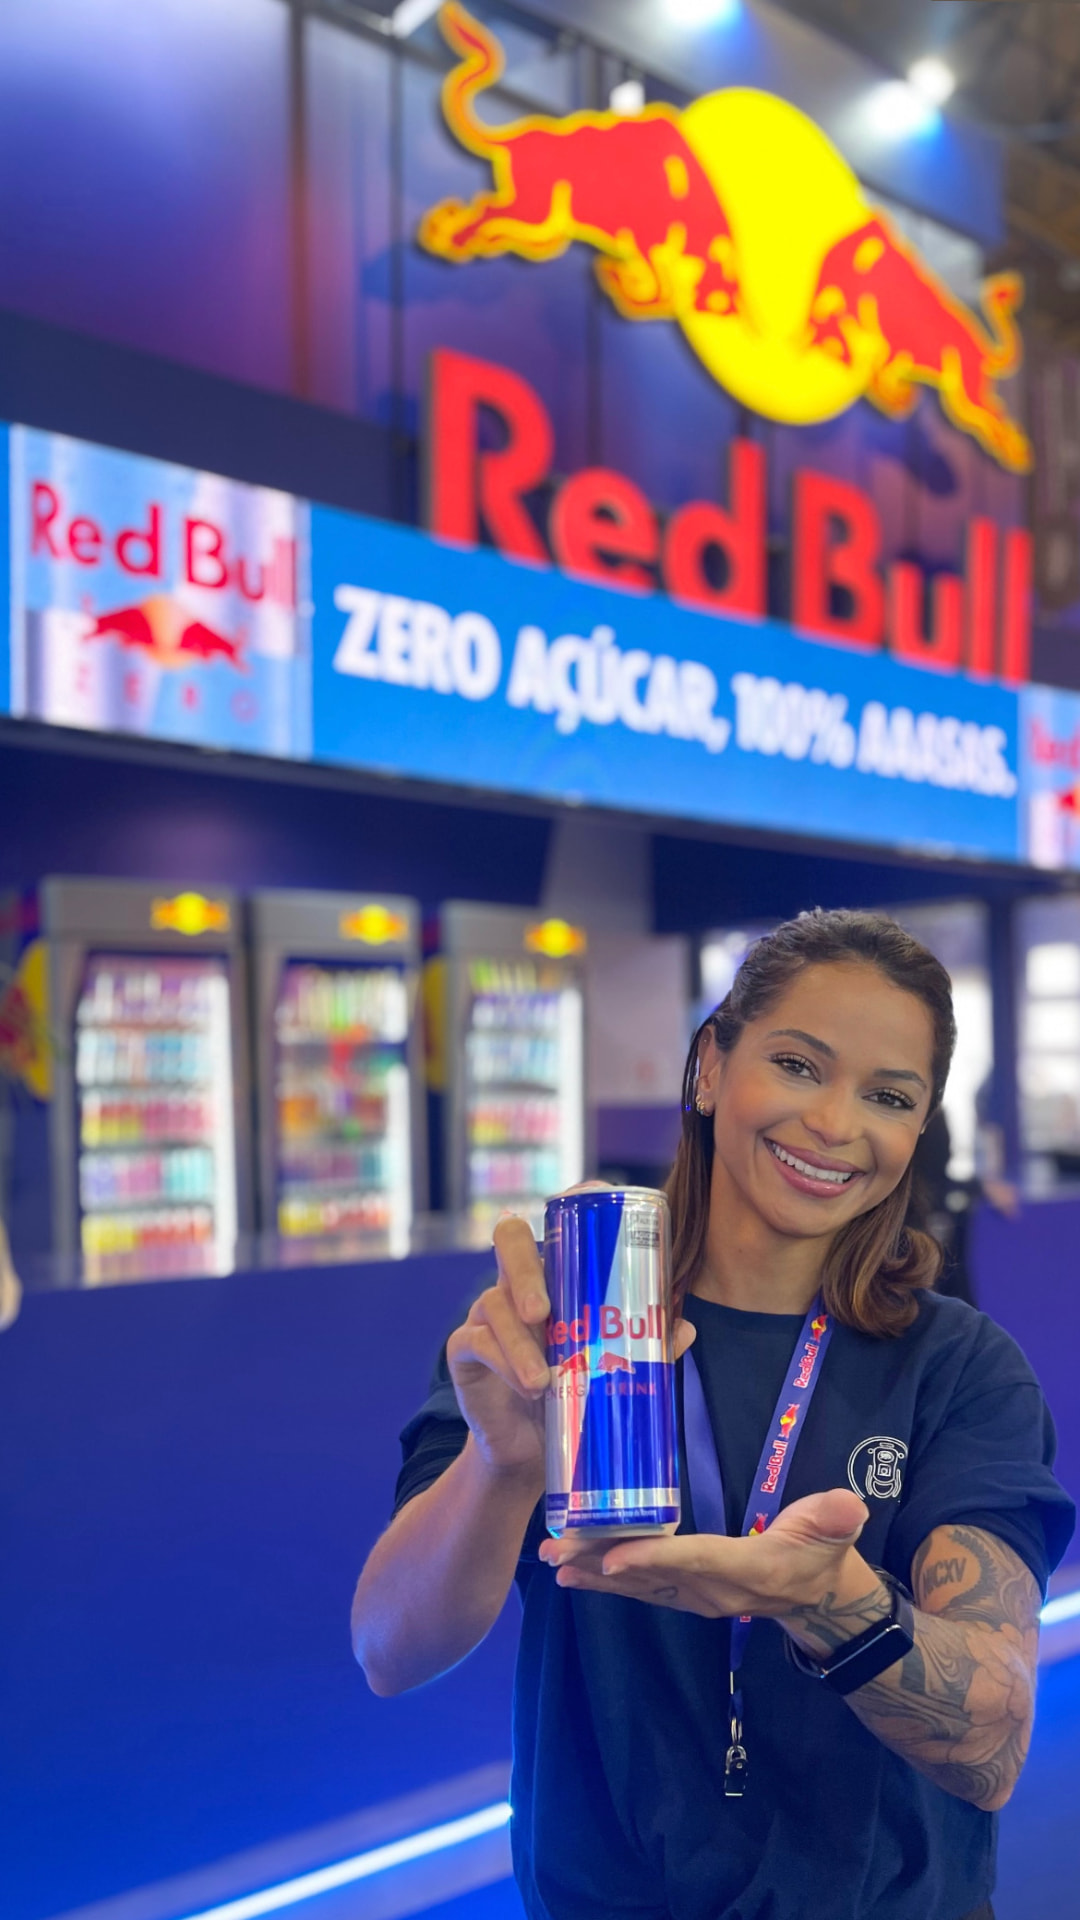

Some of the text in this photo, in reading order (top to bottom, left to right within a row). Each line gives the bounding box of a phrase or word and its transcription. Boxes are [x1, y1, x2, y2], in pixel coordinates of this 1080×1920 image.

[29, 478, 297, 611] Red Bull
[431, 346, 1033, 689] Red Bull
[333, 583, 501, 701] ZERO
[506, 624, 731, 754] AÇÚCAR,
[731, 672, 855, 770] 100%
[599, 1304, 662, 1340] Bull
